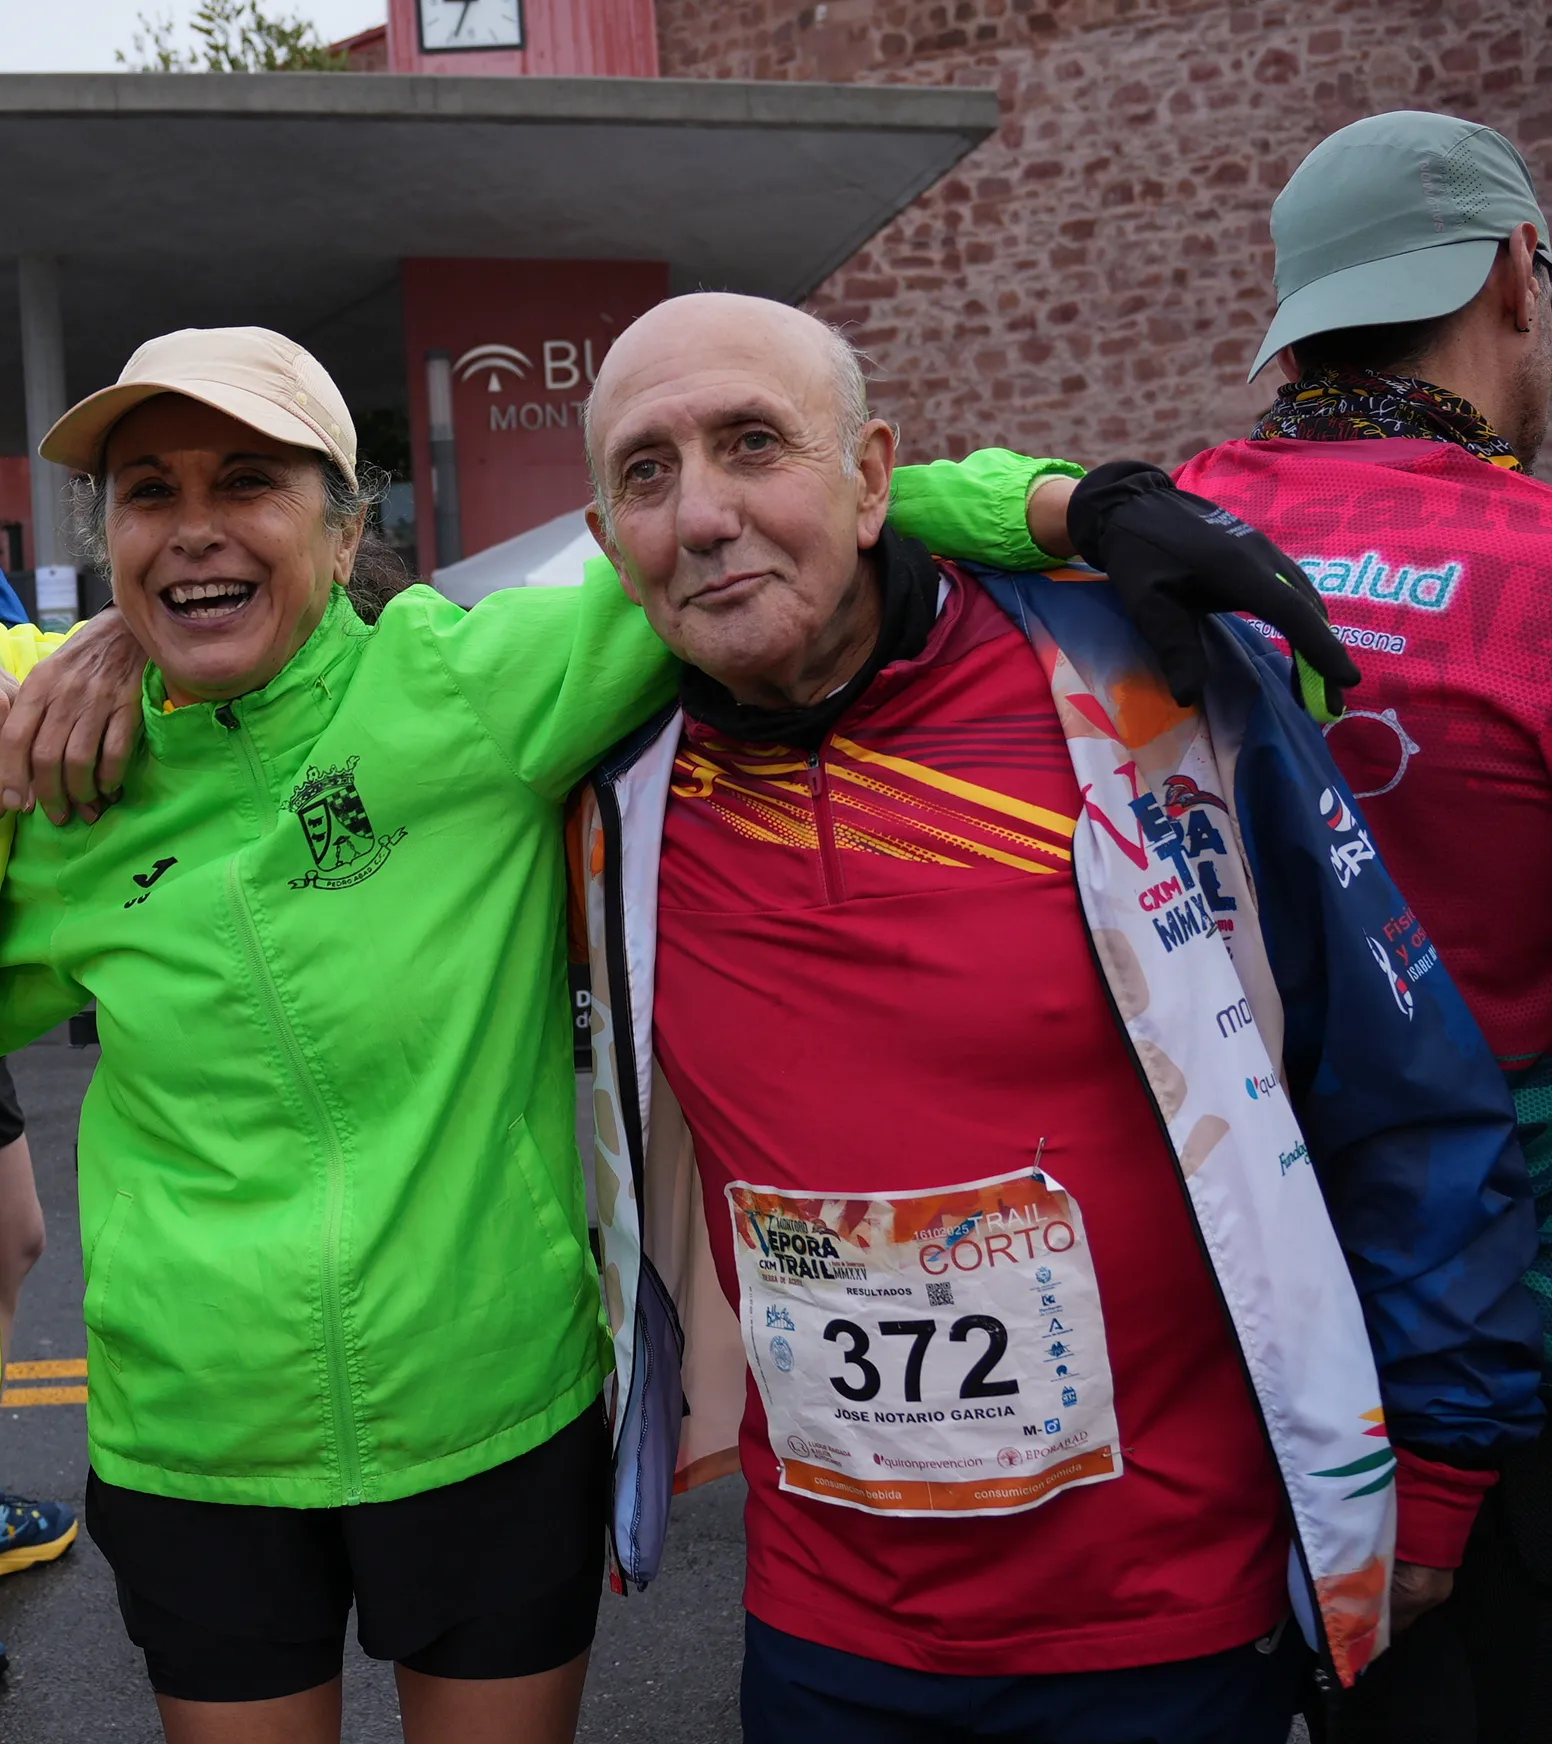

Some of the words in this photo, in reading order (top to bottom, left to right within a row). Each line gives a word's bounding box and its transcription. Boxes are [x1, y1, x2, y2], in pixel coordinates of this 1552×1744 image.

[326, 878, 353, 888] PEDRO
[353, 866, 373, 883] ABAD
[914, 1224, 970, 1242] 16102025
[967, 1202, 1048, 1235] TRAIL
[767, 1230, 840, 1260] EPORA
[919, 1220, 1076, 1276] CORTO
[759, 1259, 777, 1272] CXM
[774, 1253, 835, 1280] TRAIL
[846, 1286, 912, 1298] RESULTADOS
[823, 1314, 1021, 1403] 372
[834, 1408, 870, 1423] JOSE
[875, 1410, 945, 1424] NOTARIO
[950, 1405, 1016, 1421] GARCIA
[1025, 1430, 1089, 1461] EPORABAD
[1046, 1463, 1083, 1486] comida
[865, 1489, 902, 1501] bebida
